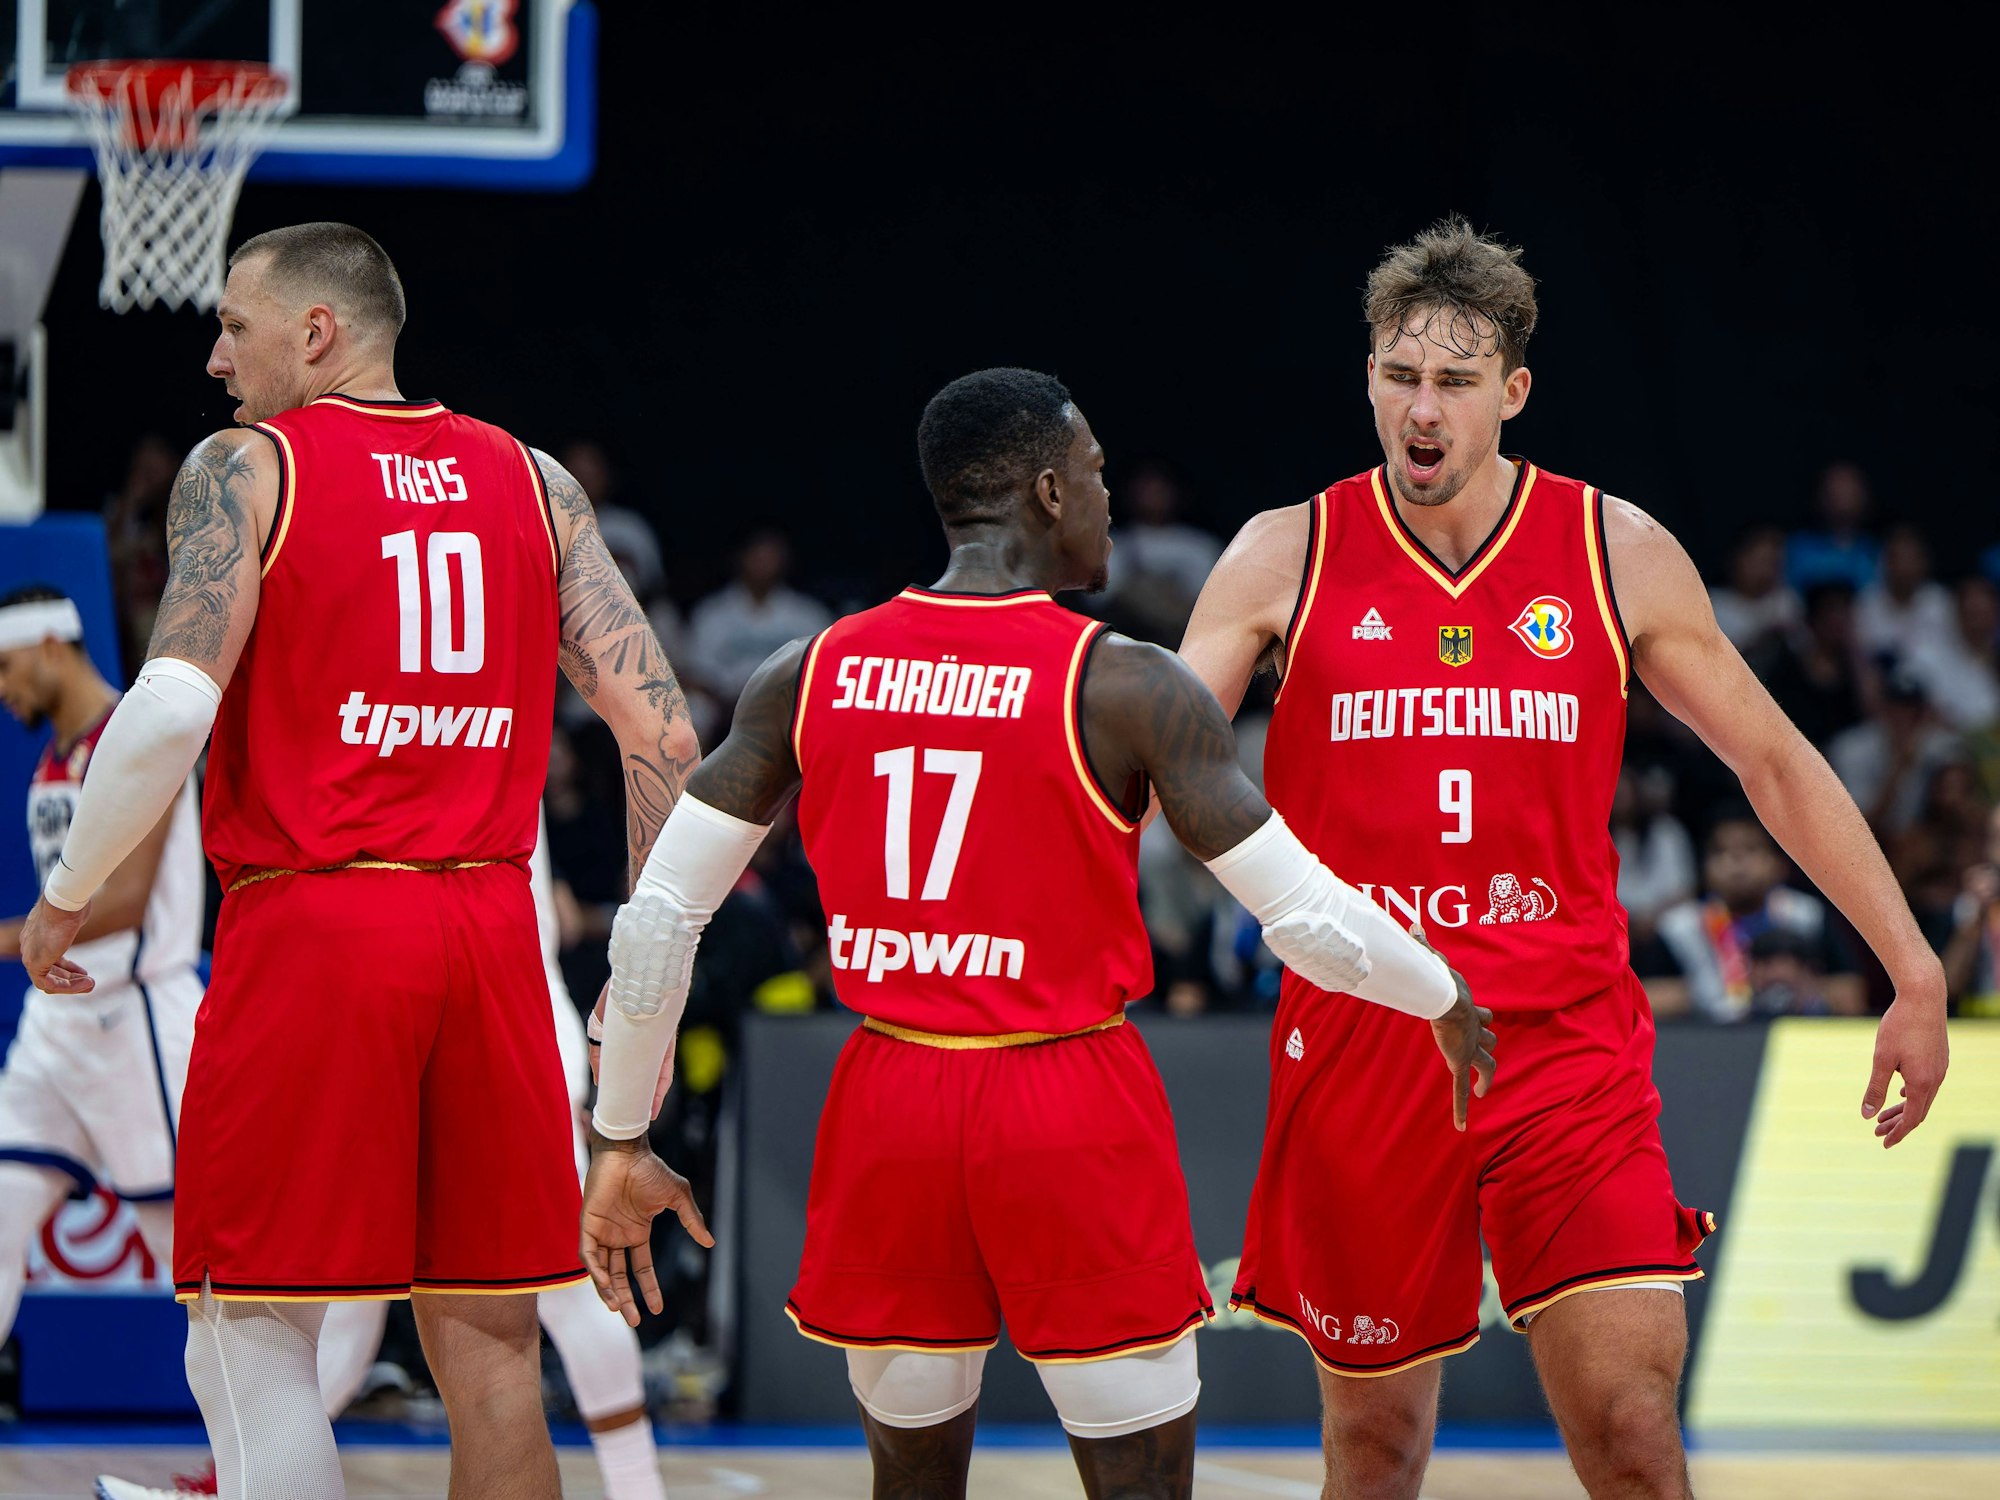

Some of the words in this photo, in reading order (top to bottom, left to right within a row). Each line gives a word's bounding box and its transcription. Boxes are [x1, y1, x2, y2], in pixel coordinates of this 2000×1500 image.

[371, 452, 468, 505] THEIS
[381, 529, 485, 674] 10
[1352, 625, 1393, 640] PEAK
[832, 655, 1032, 718] SCHRÖDER
[1330, 687, 1579, 743] DEUTSCHLAND
[338, 691, 514, 757] tipwin
[874, 745, 983, 901] 17
[1439, 769, 1472, 843] 9
[828, 914, 1025, 983] tipwin
[1298, 1291, 1342, 1341] ING
